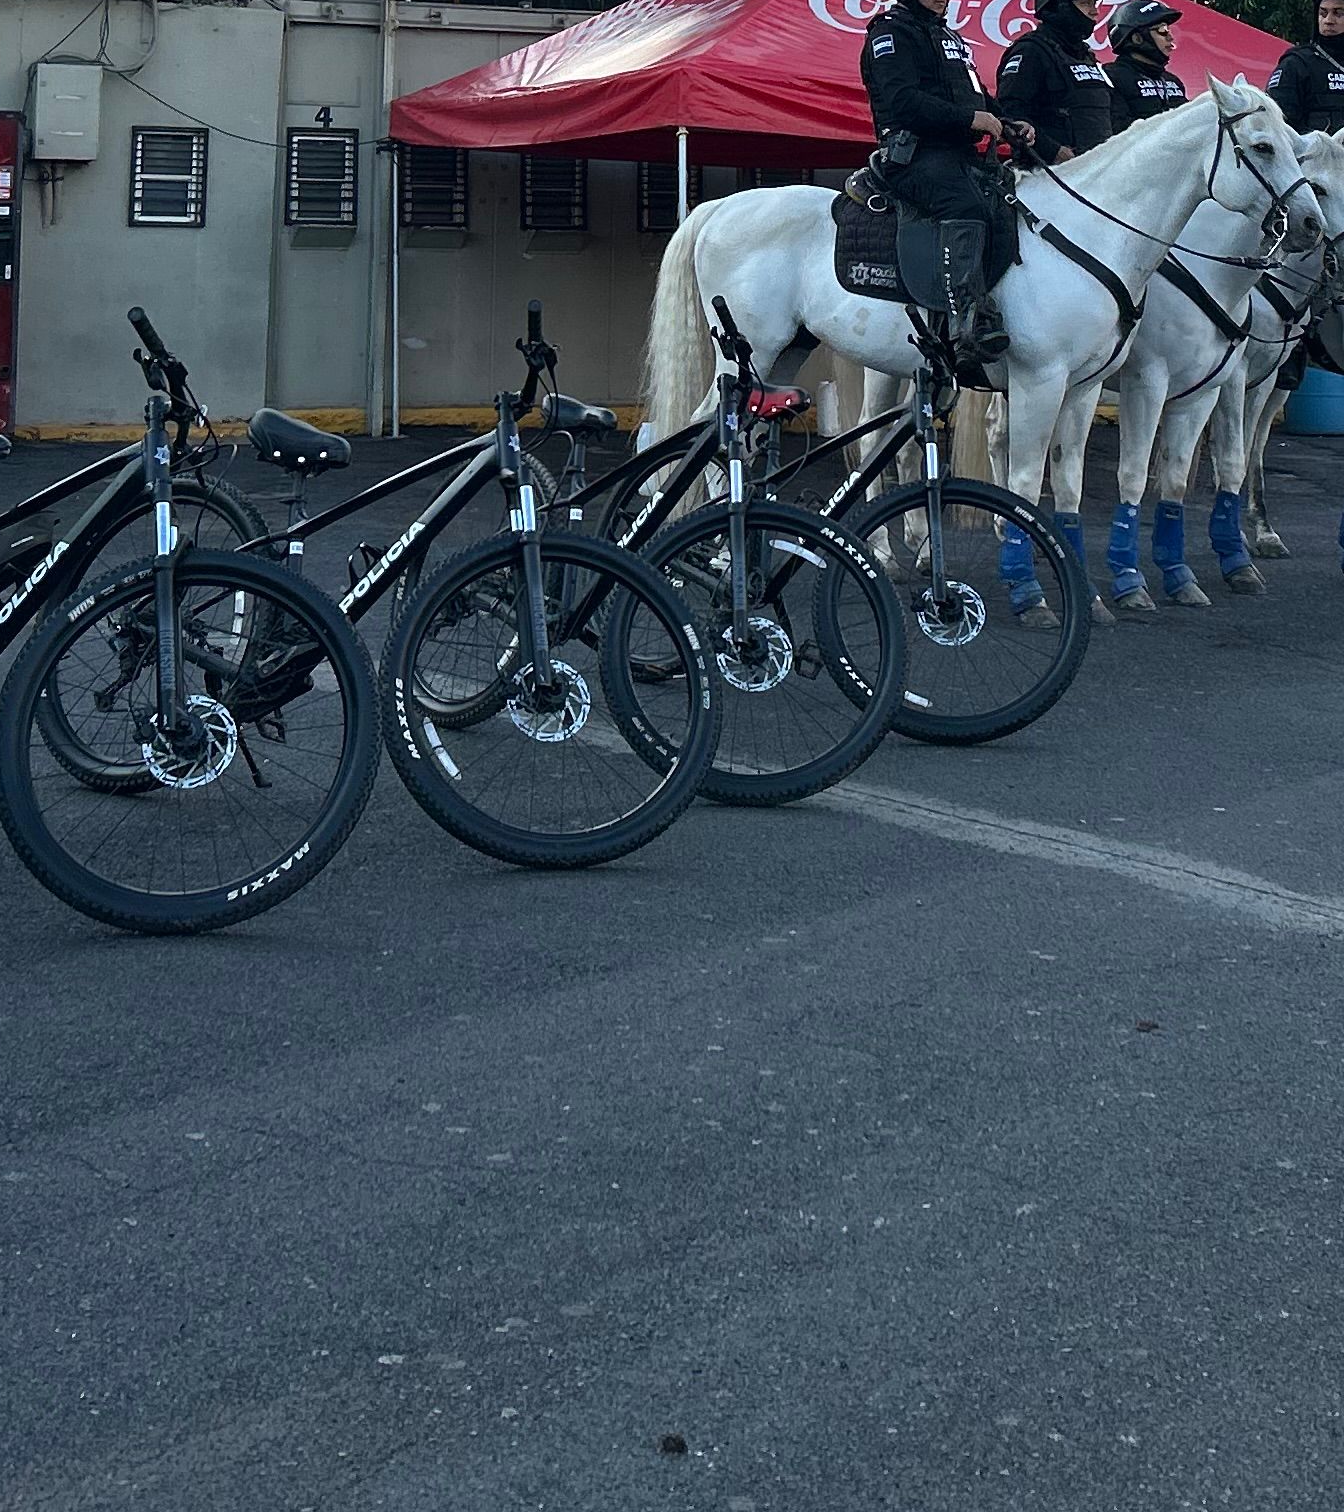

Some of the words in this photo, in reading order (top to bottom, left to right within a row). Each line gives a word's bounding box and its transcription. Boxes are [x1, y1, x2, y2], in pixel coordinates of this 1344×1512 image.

[315, 105, 334, 129] 4
[819, 470, 862, 517] LICIA
[338, 521, 426, 614] POLICIA
[819, 527, 878, 580] MAXXIS
[839, 656, 874, 697] AXXIS
[395, 677, 421, 759] MAXXIS
[226, 841, 310, 901] MAXXIS
